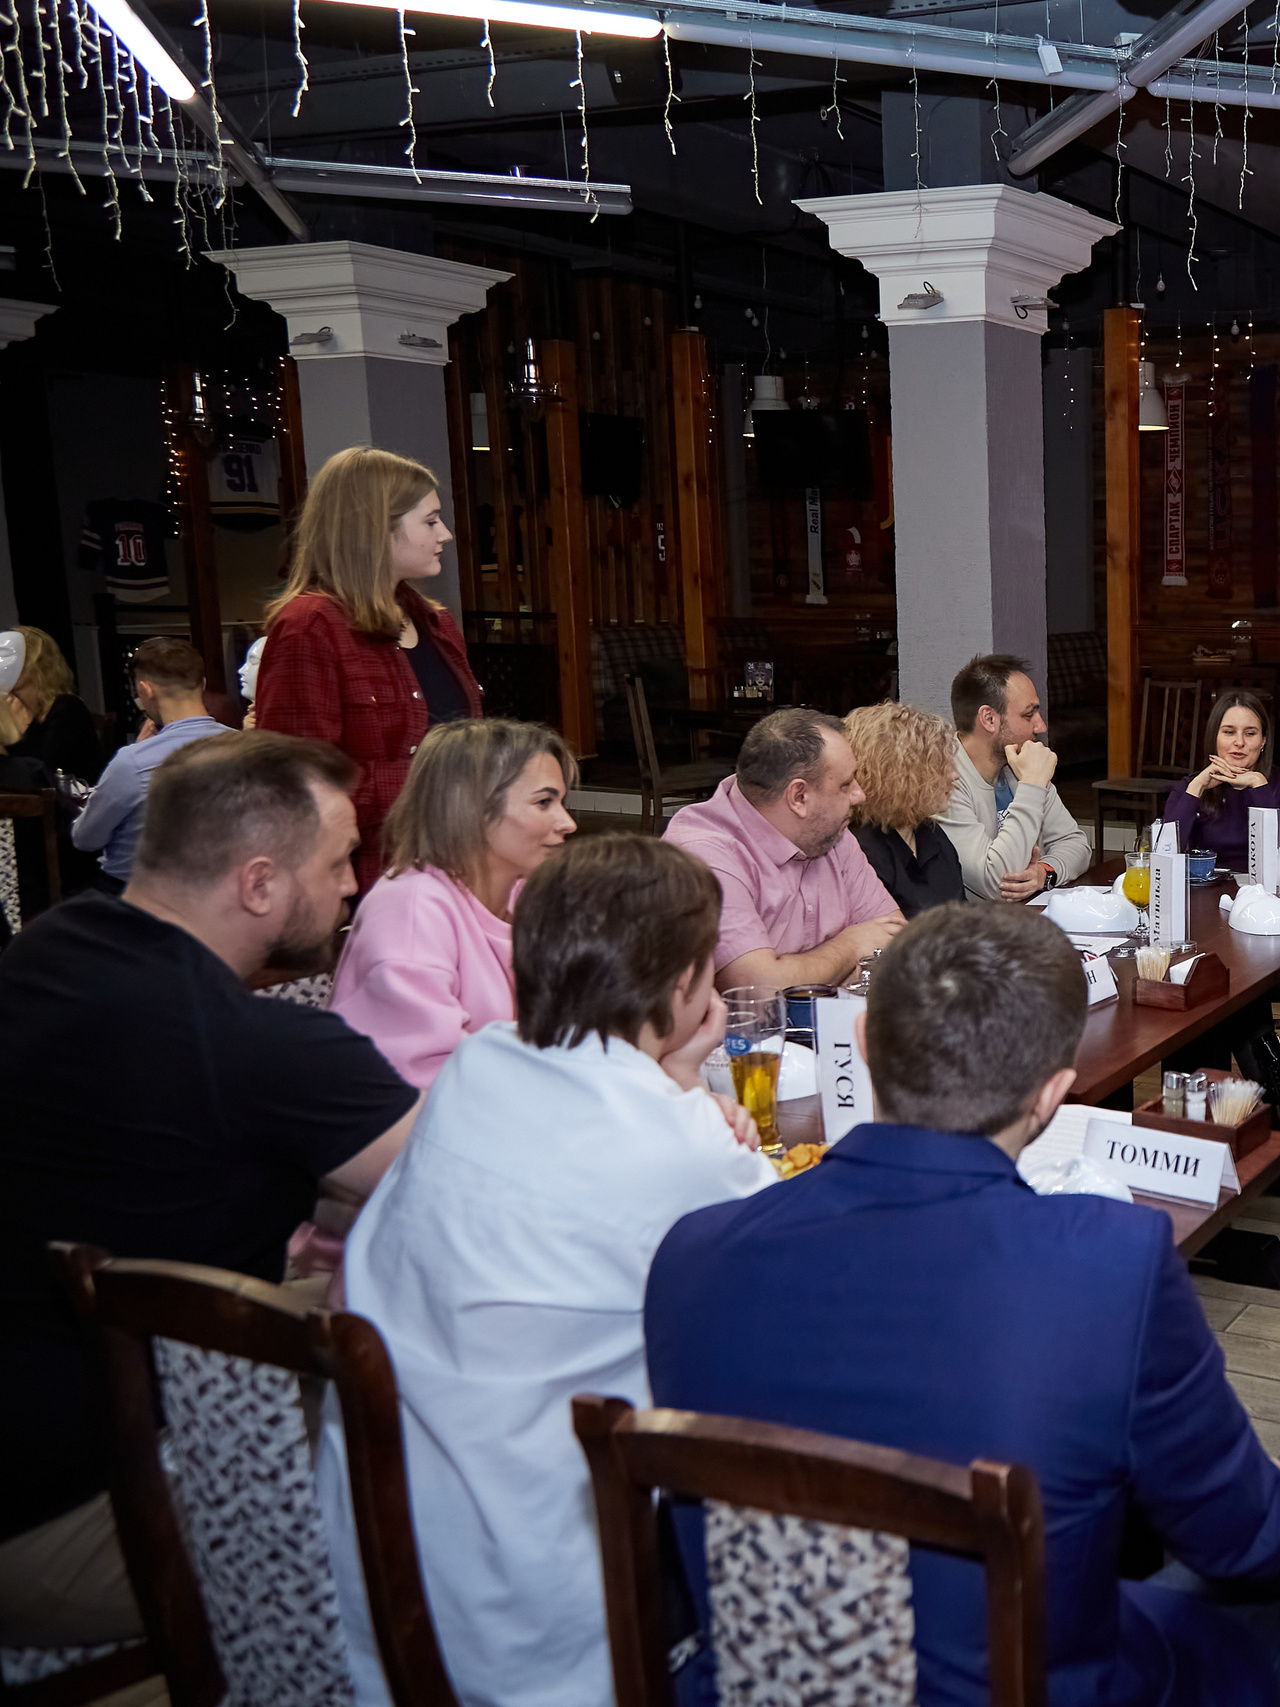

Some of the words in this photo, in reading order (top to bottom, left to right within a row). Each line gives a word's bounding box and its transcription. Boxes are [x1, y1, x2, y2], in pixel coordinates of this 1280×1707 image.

[1168, 404, 1181, 462] ЧЕМПИОН
[222, 454, 259, 493] 91
[810, 509, 820, 535] Real
[1168, 501, 1181, 554] СПАРТАК
[115, 533, 148, 567] 10
[1250, 821, 1258, 884] ДАКОТА
[1153, 868, 1162, 945] Матильда
[833, 1042, 856, 1109] ГУСЯ
[1107, 1140, 1201, 1178] ТОММИ
